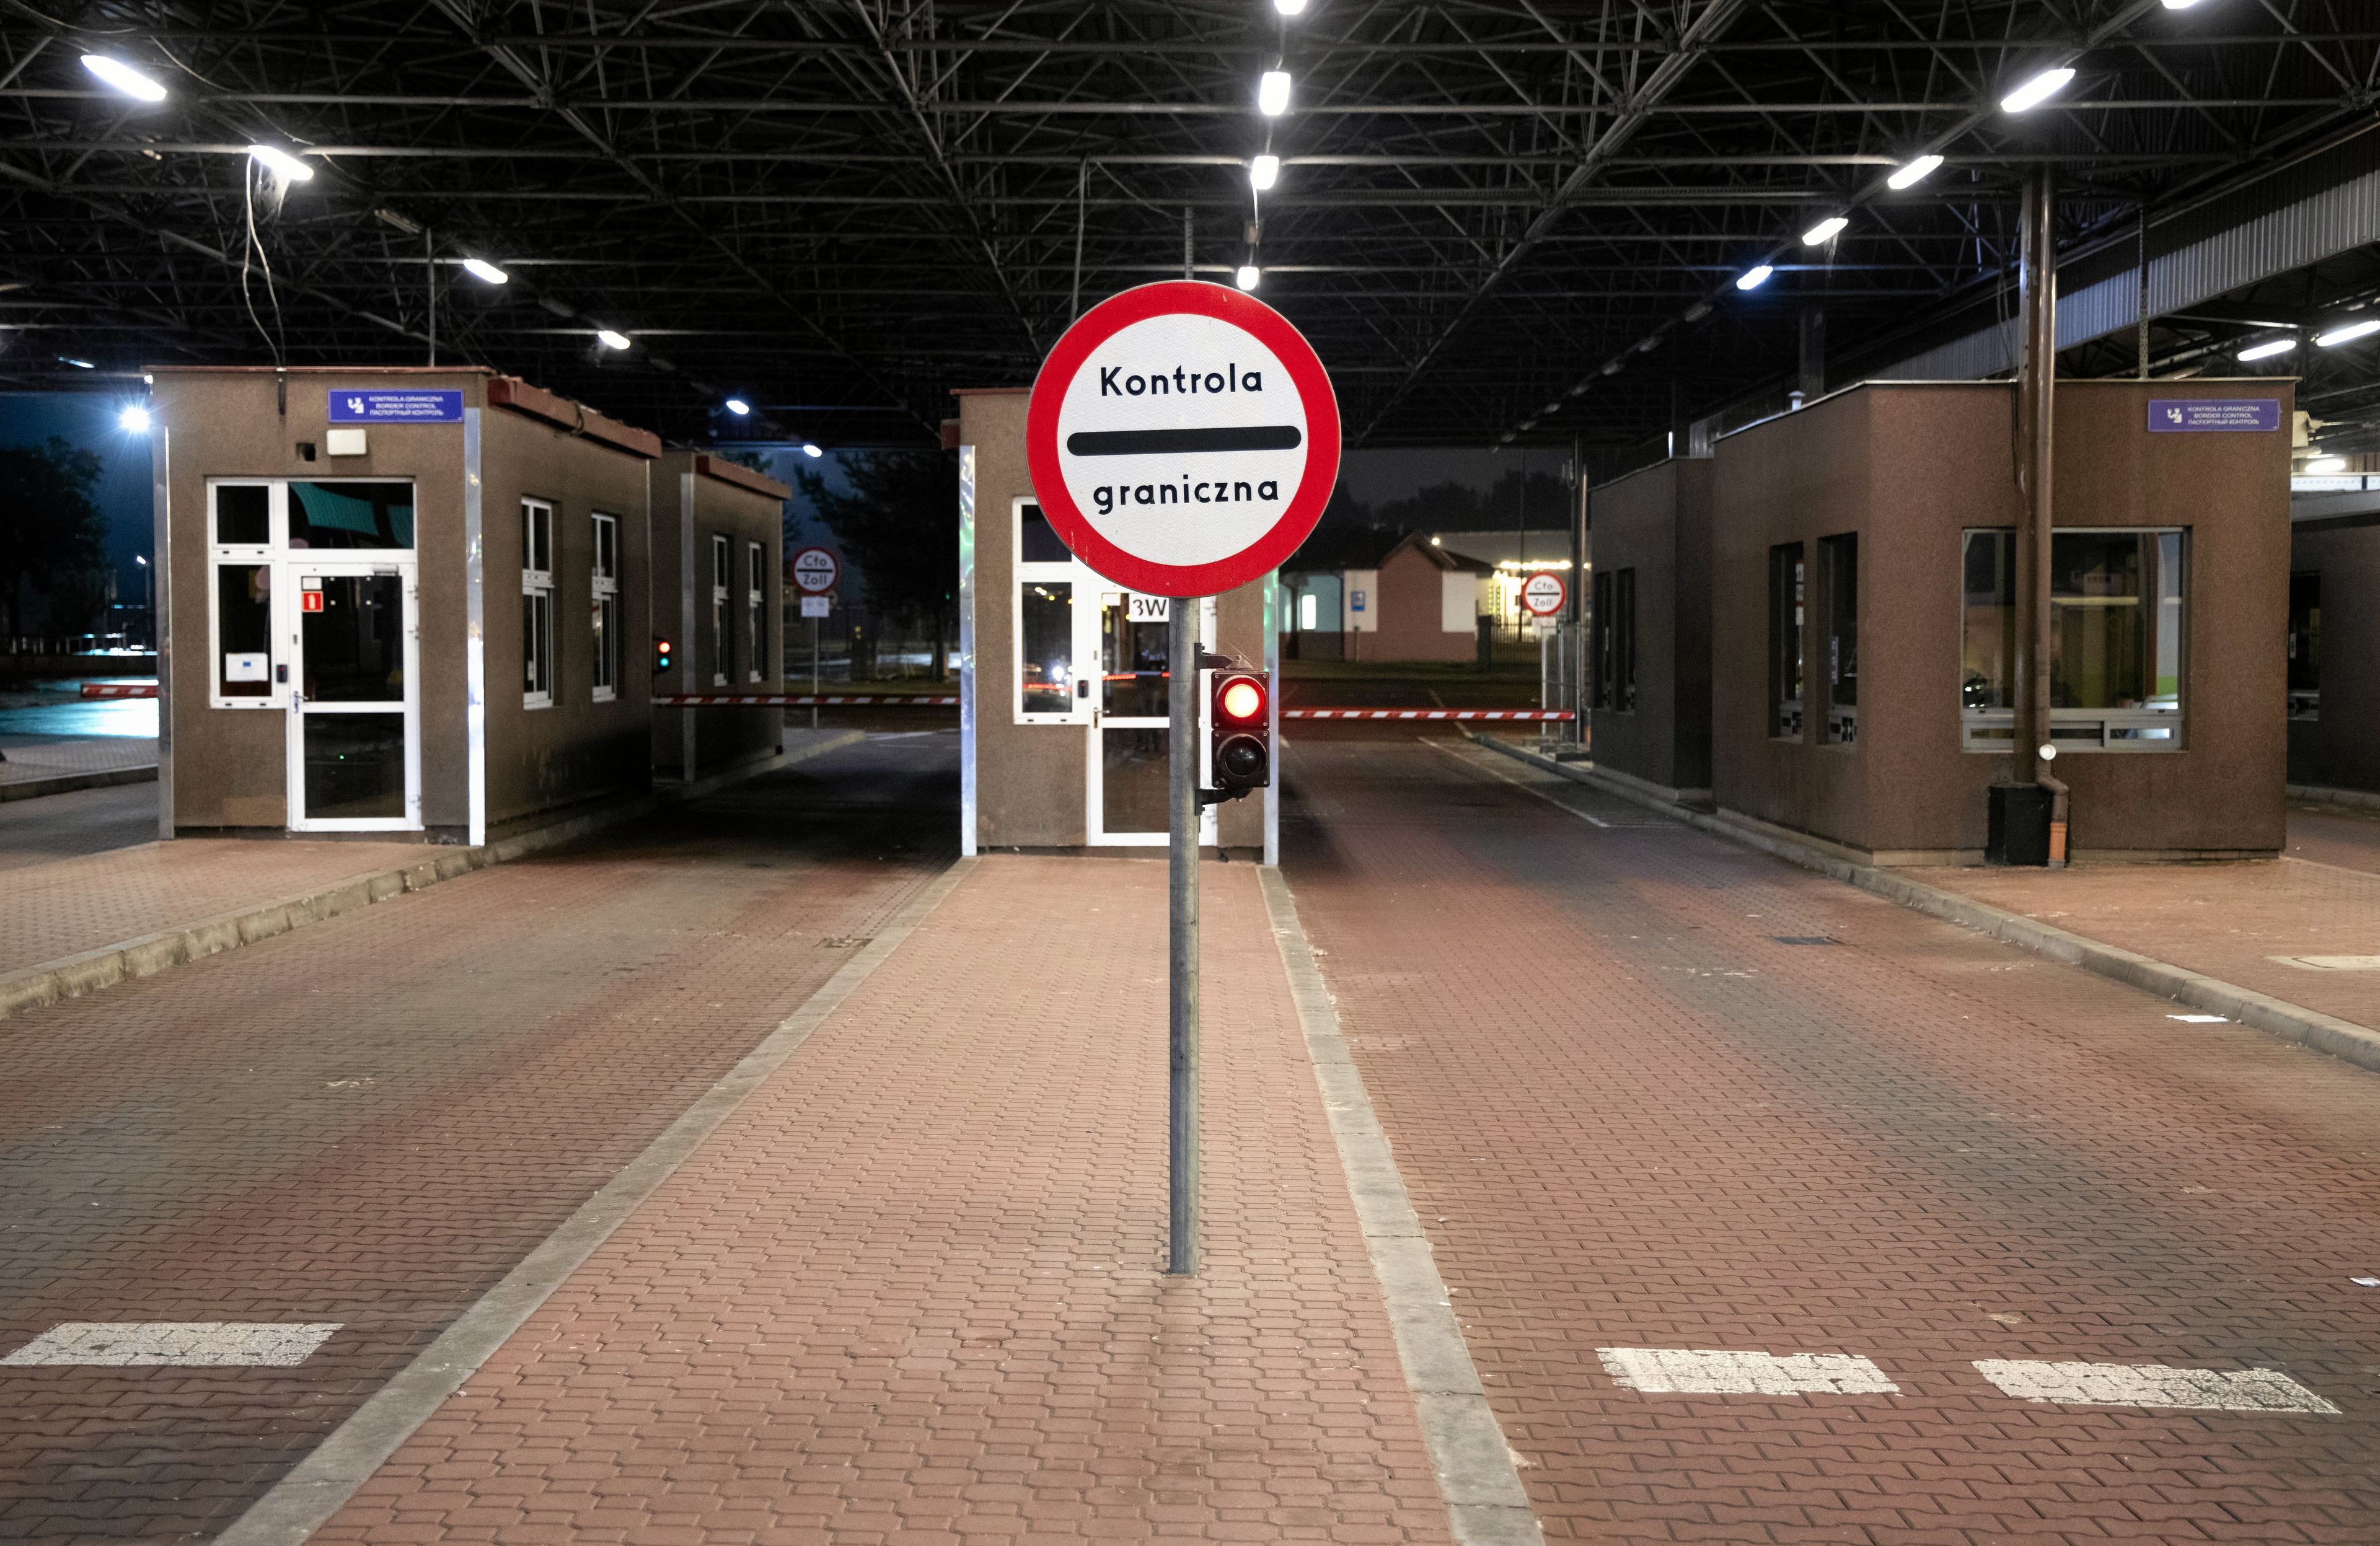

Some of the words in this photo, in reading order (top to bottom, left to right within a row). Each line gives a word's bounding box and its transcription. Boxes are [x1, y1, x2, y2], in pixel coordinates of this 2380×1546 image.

[1101, 362, 1263, 397] Kontrola
[1093, 474, 1279, 515] graniczna
[803, 574, 827, 585] Zoll
[1133, 599, 1166, 616] 3W
[1535, 598, 1552, 607] Zoll
